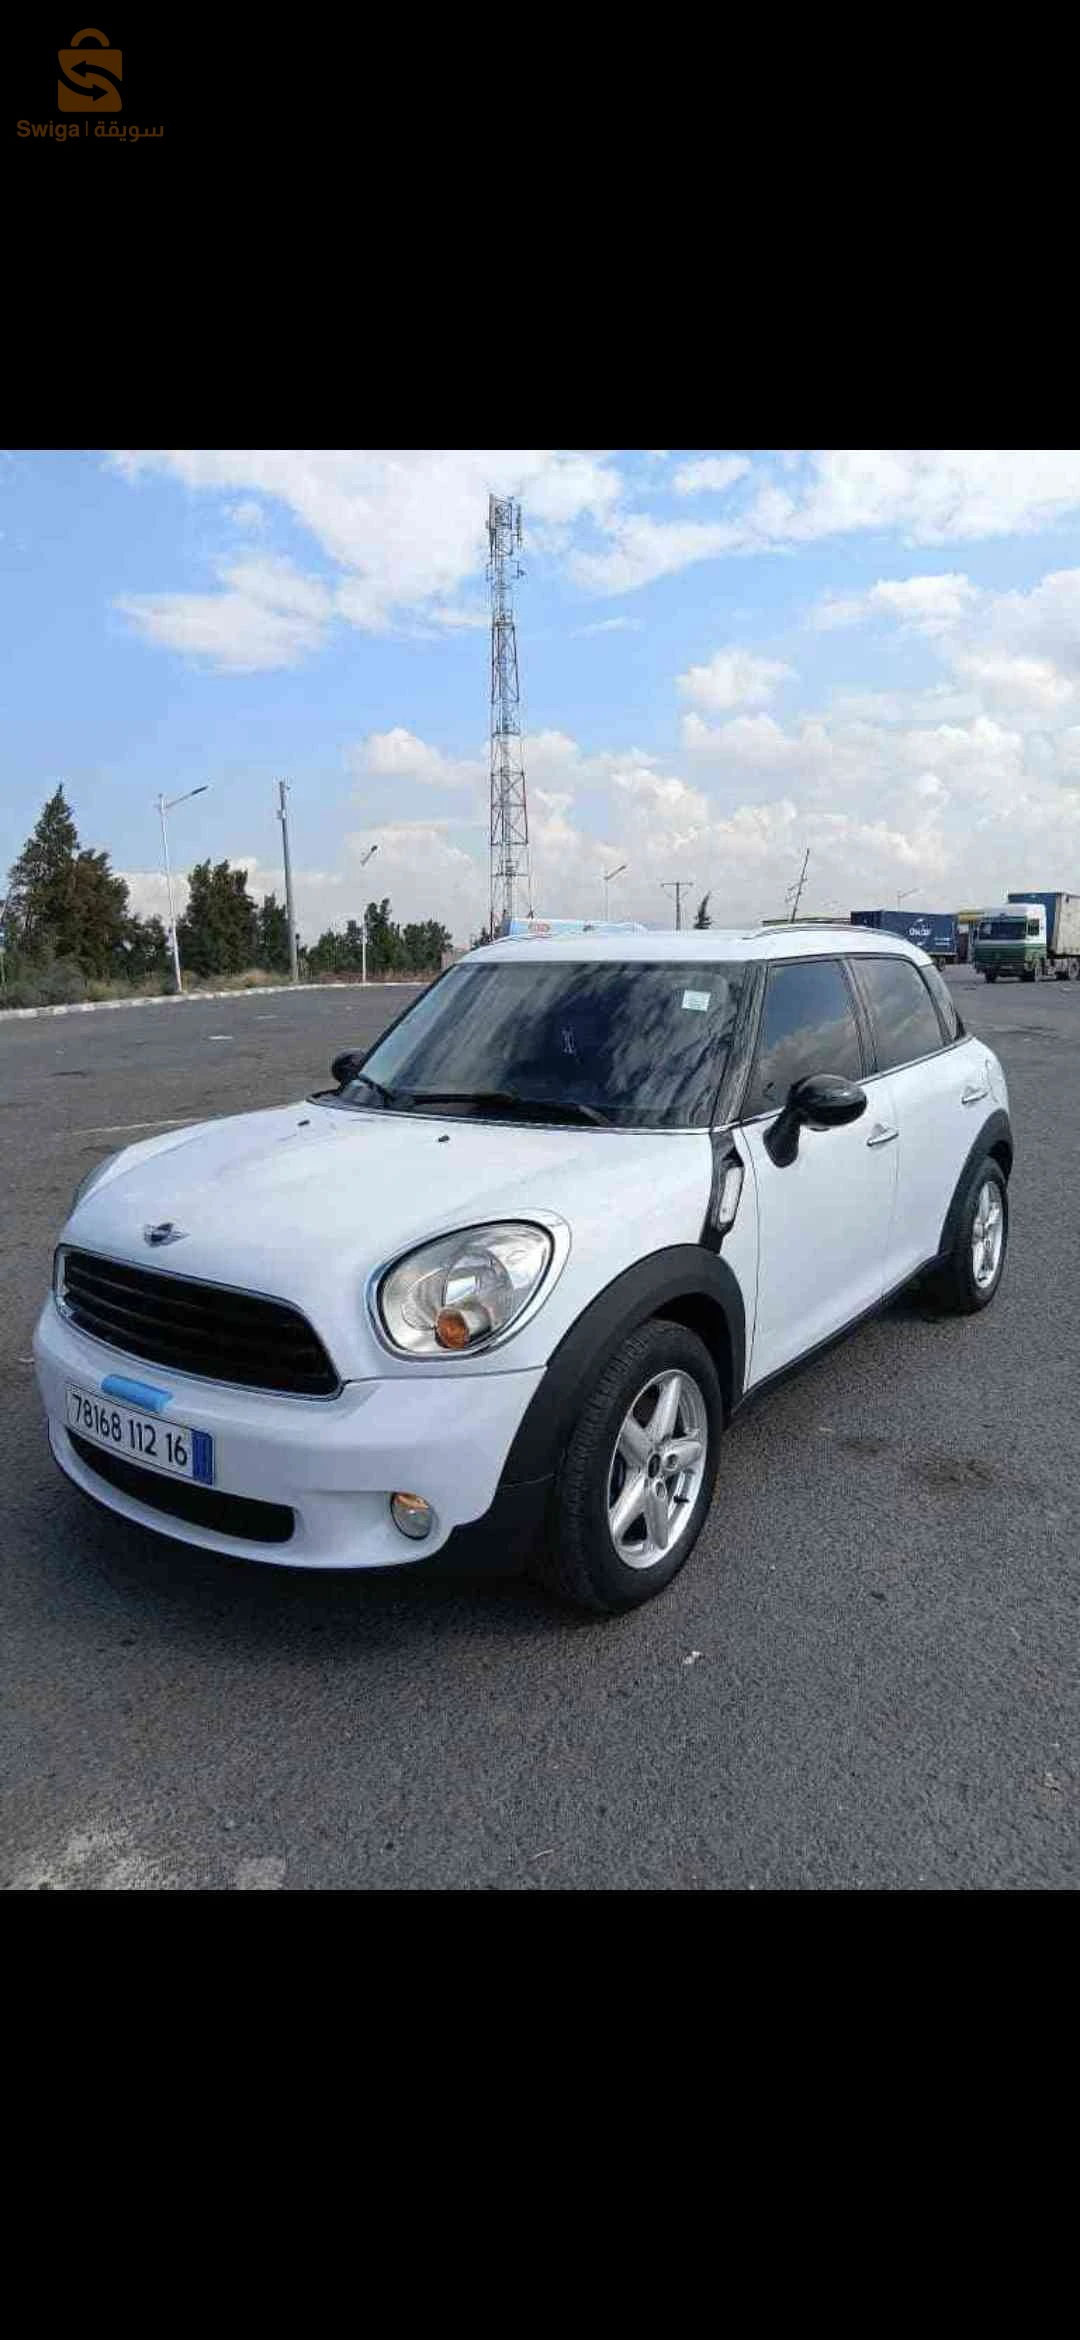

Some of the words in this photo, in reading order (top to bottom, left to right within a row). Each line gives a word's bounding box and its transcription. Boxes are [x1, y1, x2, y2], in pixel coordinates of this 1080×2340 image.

[71, 1393, 122, 1442] 78168
[128, 1419, 157, 1456] 112
[166, 1432, 188, 1466] 16
